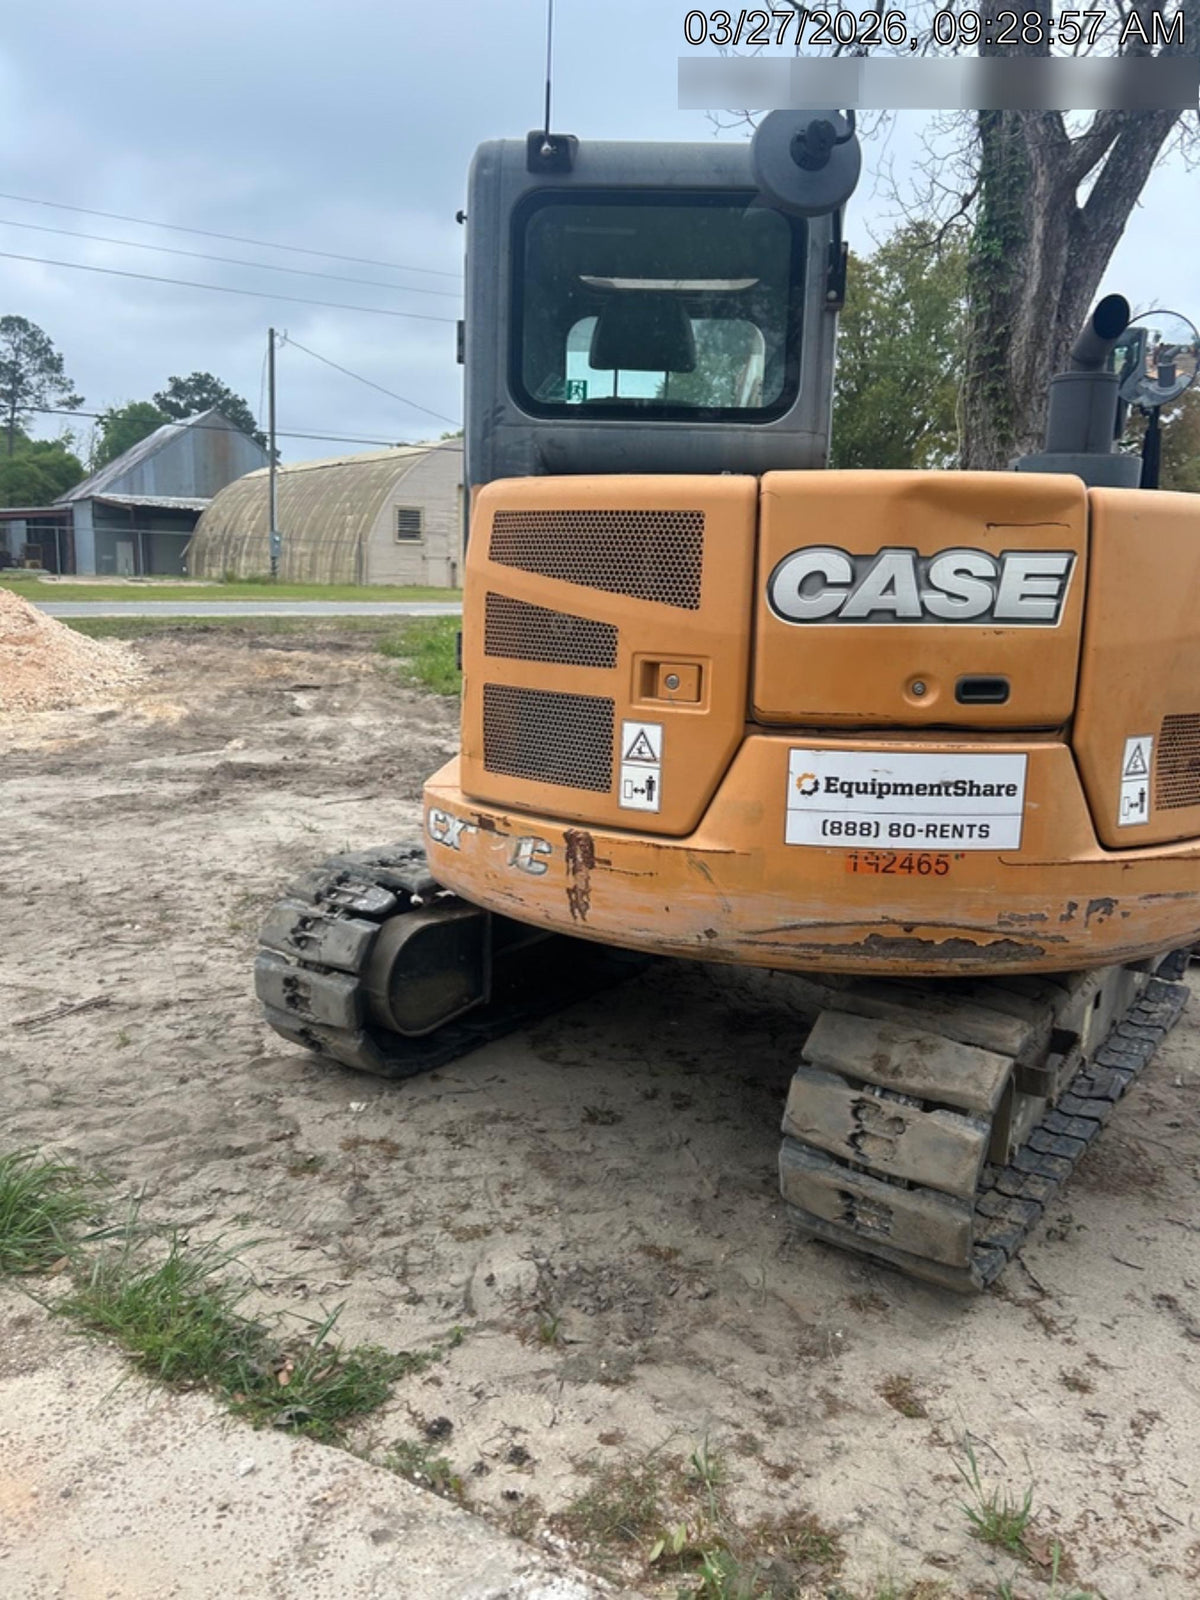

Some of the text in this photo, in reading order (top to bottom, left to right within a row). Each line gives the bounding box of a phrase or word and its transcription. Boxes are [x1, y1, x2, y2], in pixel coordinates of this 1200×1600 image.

[769, 546, 1074, 622] CASE
[823, 776, 1018, 799] EquipmentShare
[821, 819, 990, 839] (888) 80-RENTS
